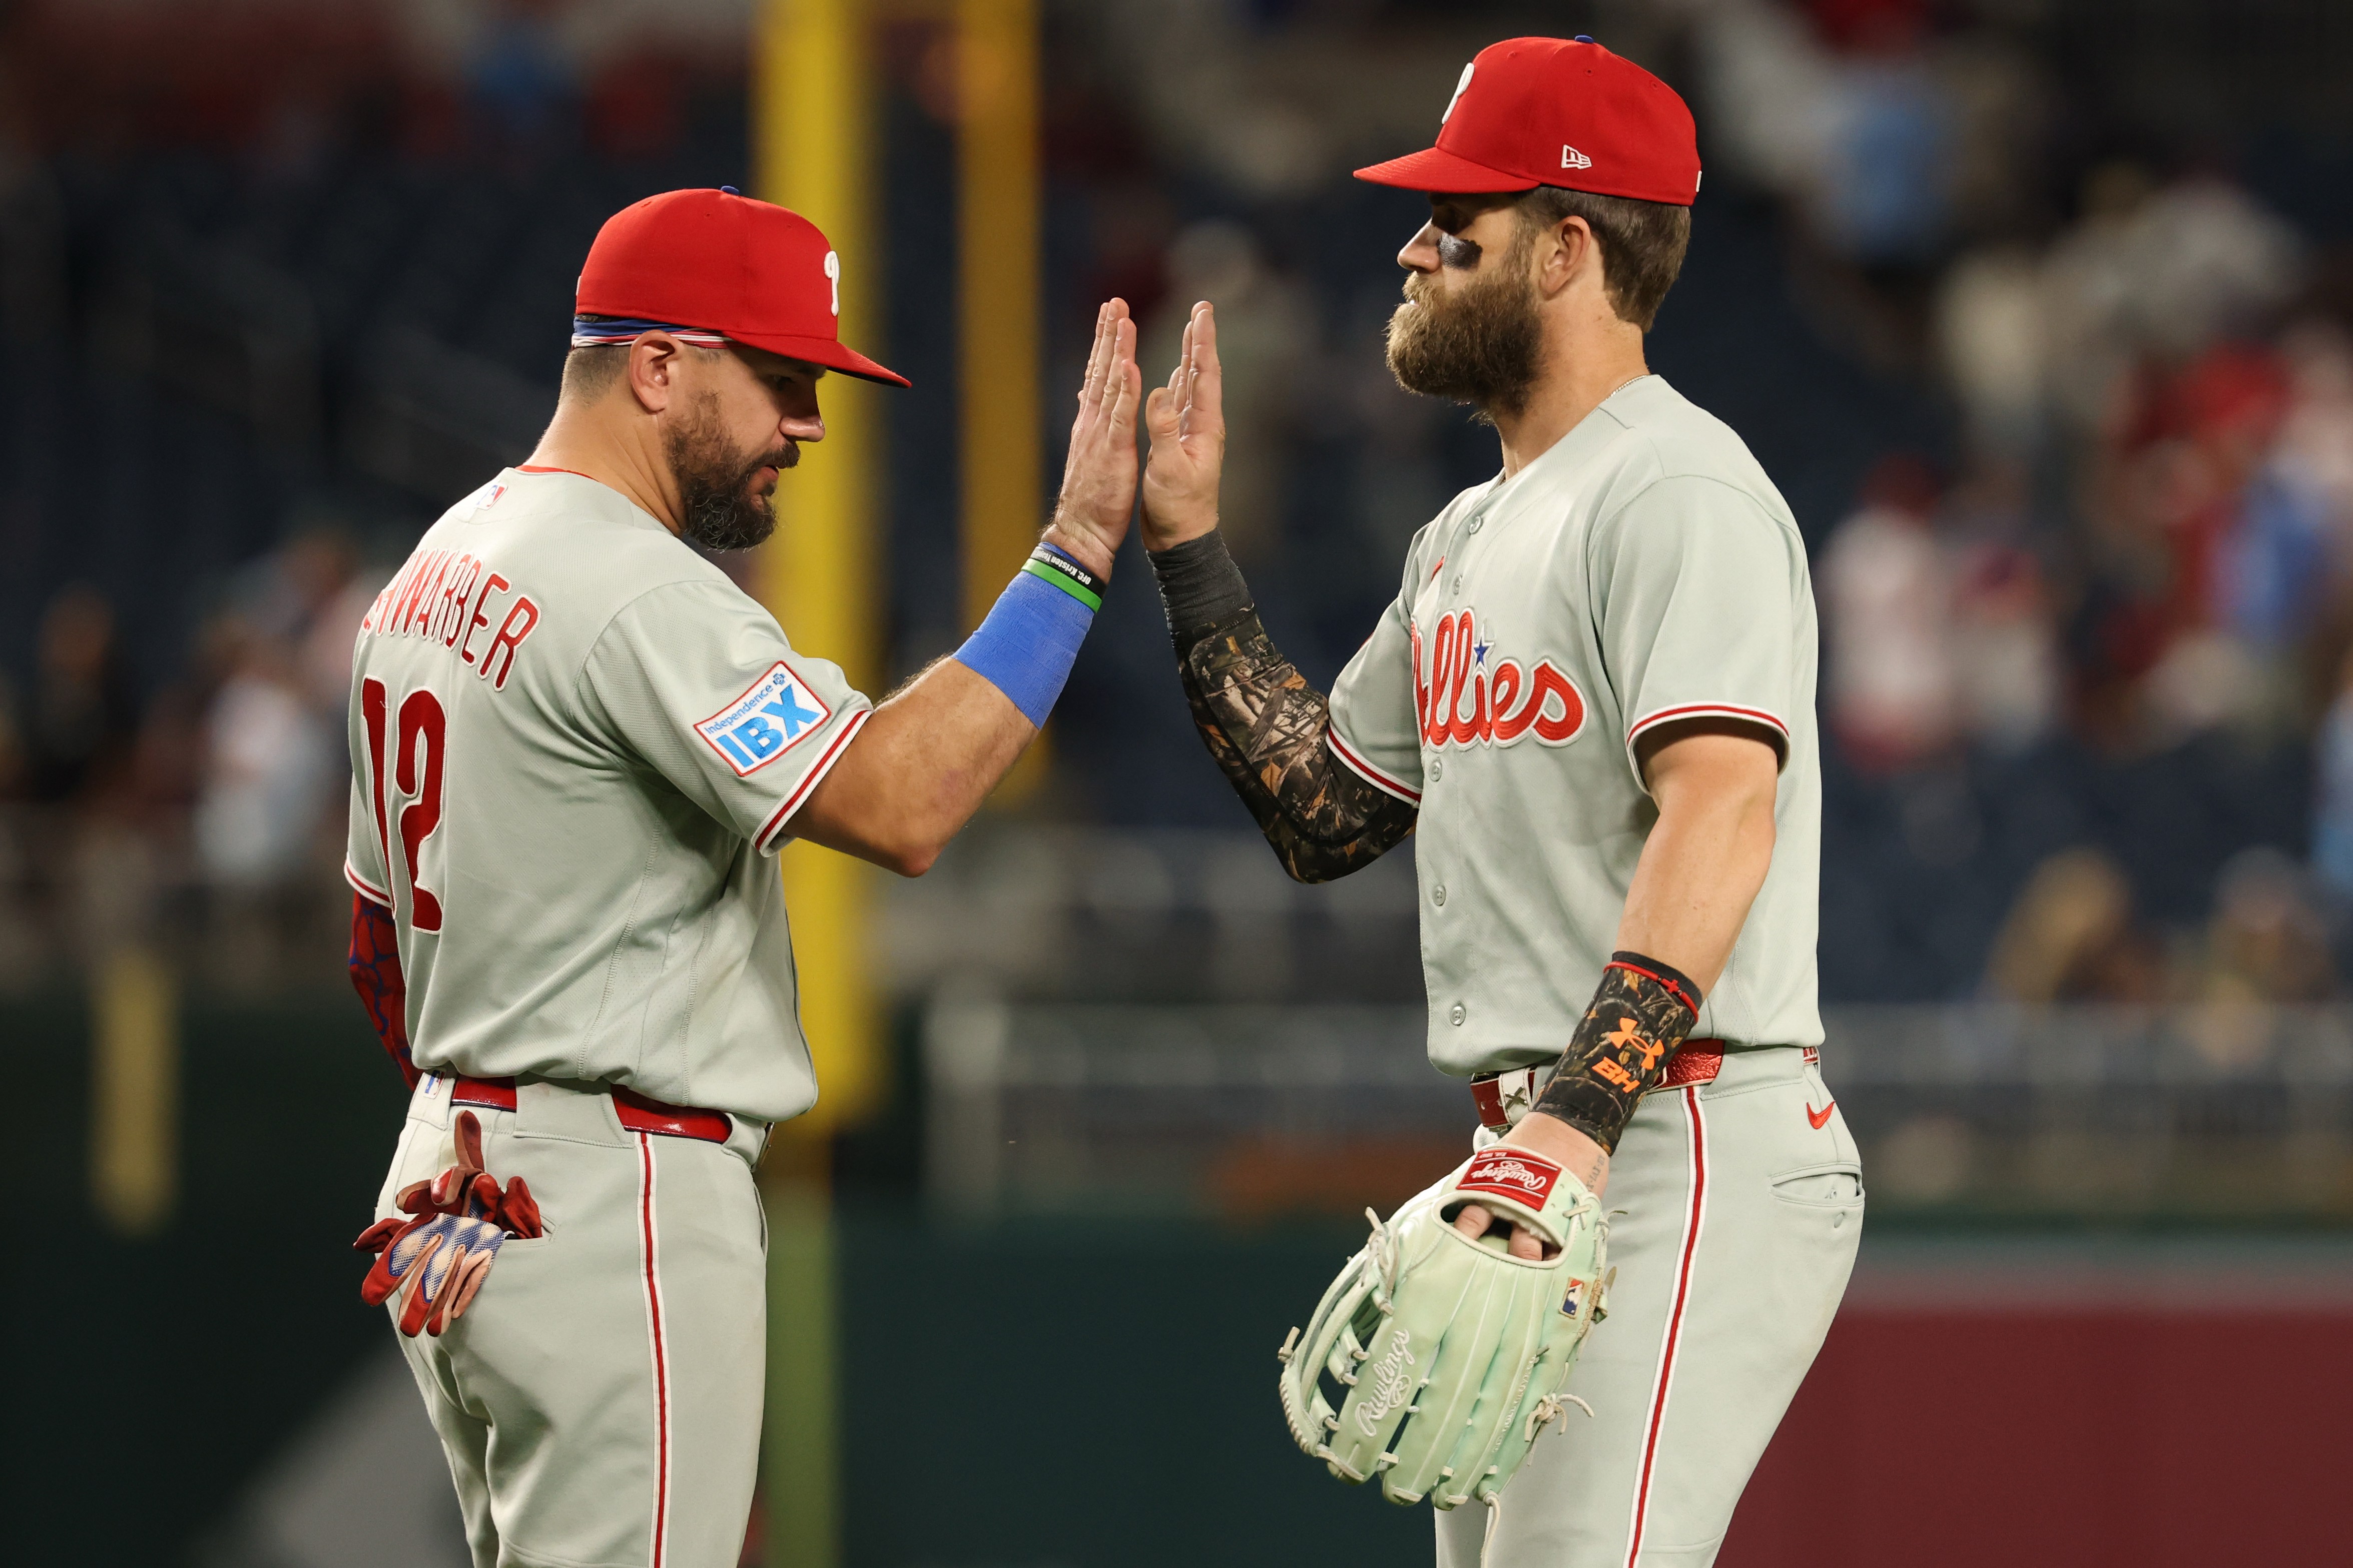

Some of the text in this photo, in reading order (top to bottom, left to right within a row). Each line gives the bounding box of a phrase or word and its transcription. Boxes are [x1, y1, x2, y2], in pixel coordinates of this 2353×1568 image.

[1051, 556, 1078, 576] Kristen
[704, 684, 774, 735] Independence
[716, 683, 821, 768] IBX
[362, 675, 447, 935] 12
[1592, 1056, 1640, 1094] BH
[1471, 1163, 1547, 1190] Rawlings
[1356, 1329, 1415, 1437] Rawlings
